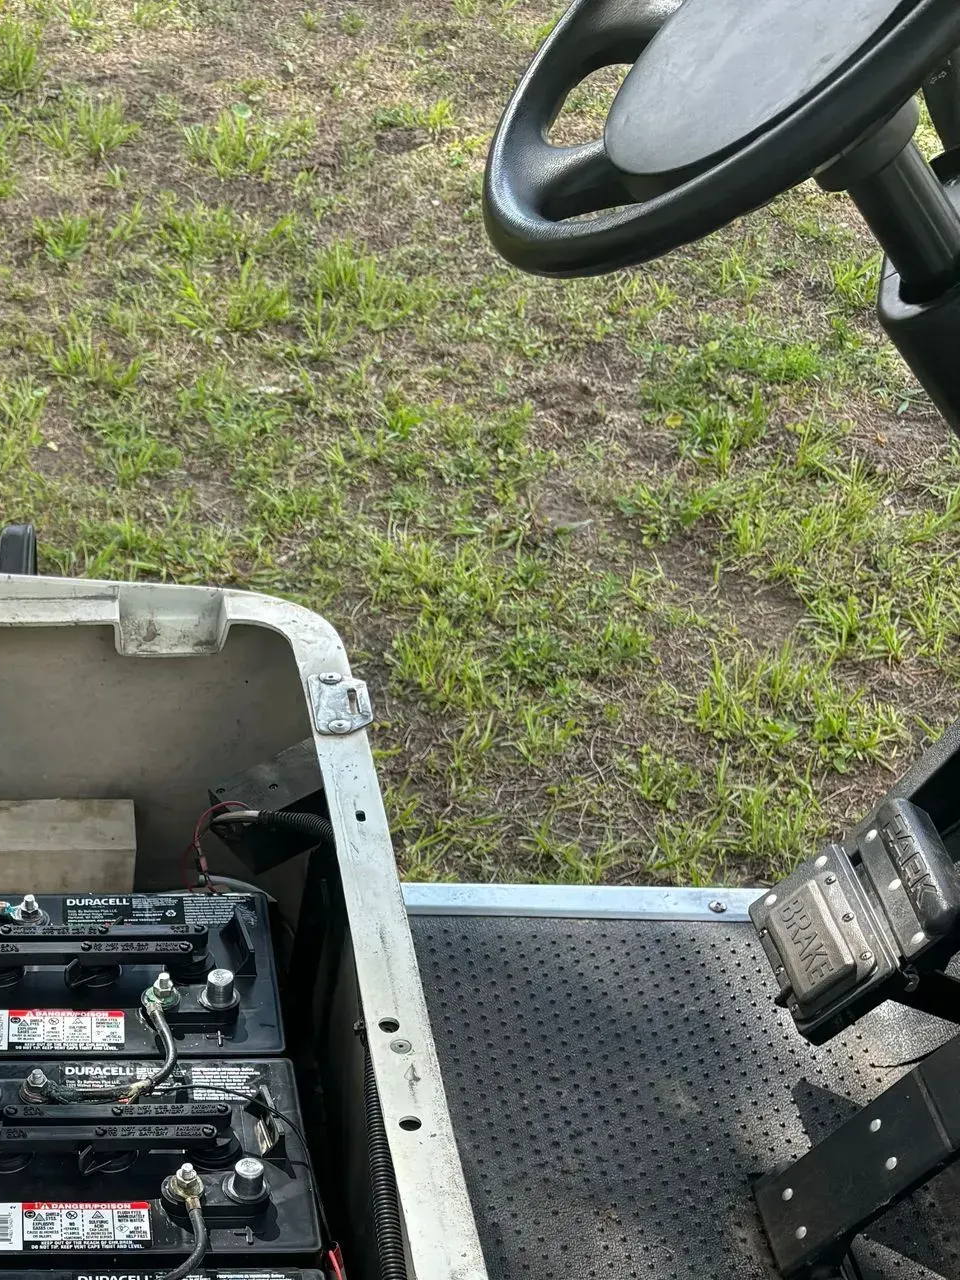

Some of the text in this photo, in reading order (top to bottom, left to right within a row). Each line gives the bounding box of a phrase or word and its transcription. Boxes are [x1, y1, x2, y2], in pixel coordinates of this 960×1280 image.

[66, 898, 130, 906] DURACELL
[780, 899, 834, 987] BRAKE
[65, 1067, 132, 1076] DURACELL
